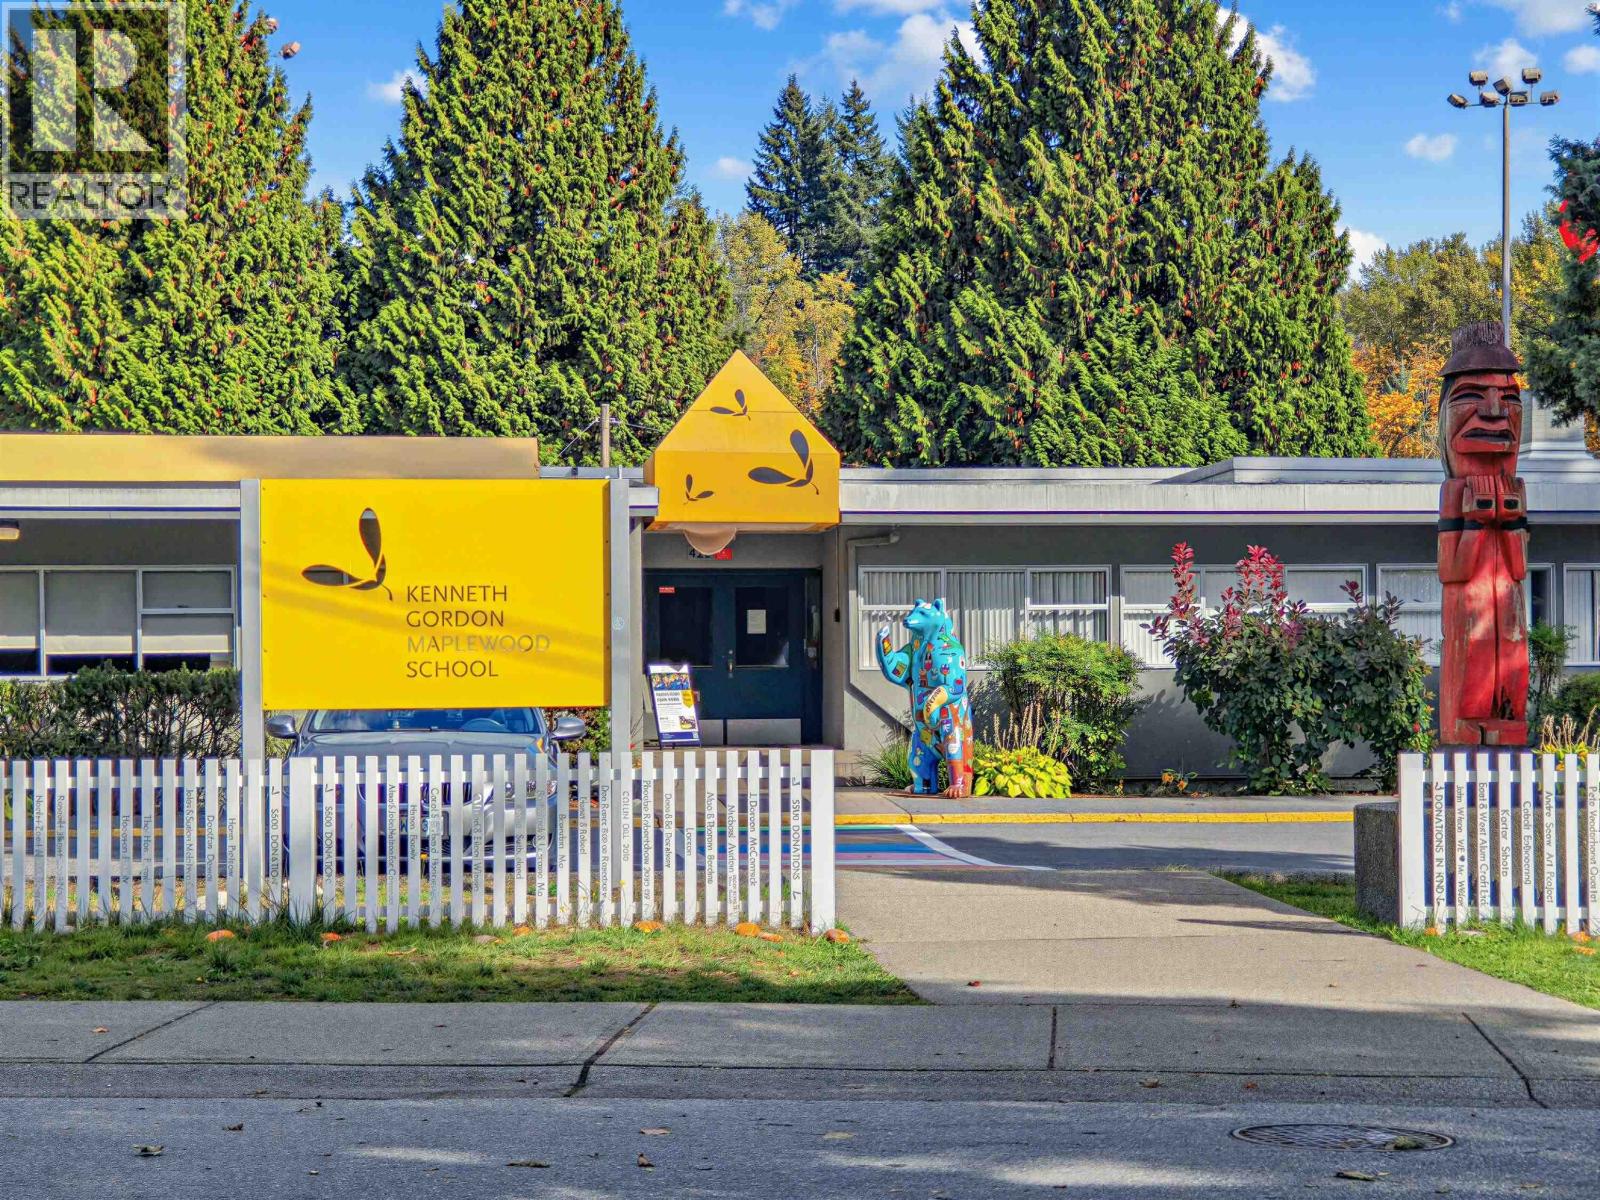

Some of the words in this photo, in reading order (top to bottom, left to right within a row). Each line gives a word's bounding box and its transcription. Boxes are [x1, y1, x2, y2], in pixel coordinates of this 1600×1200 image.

[407, 585, 507, 602] KENNETH
[406, 610, 504, 628] GORDON
[407, 634, 550, 652] MAPLEWOOD
[406, 660, 499, 678] SCHOOL
[1435, 794, 1444, 853] DONATIONS
